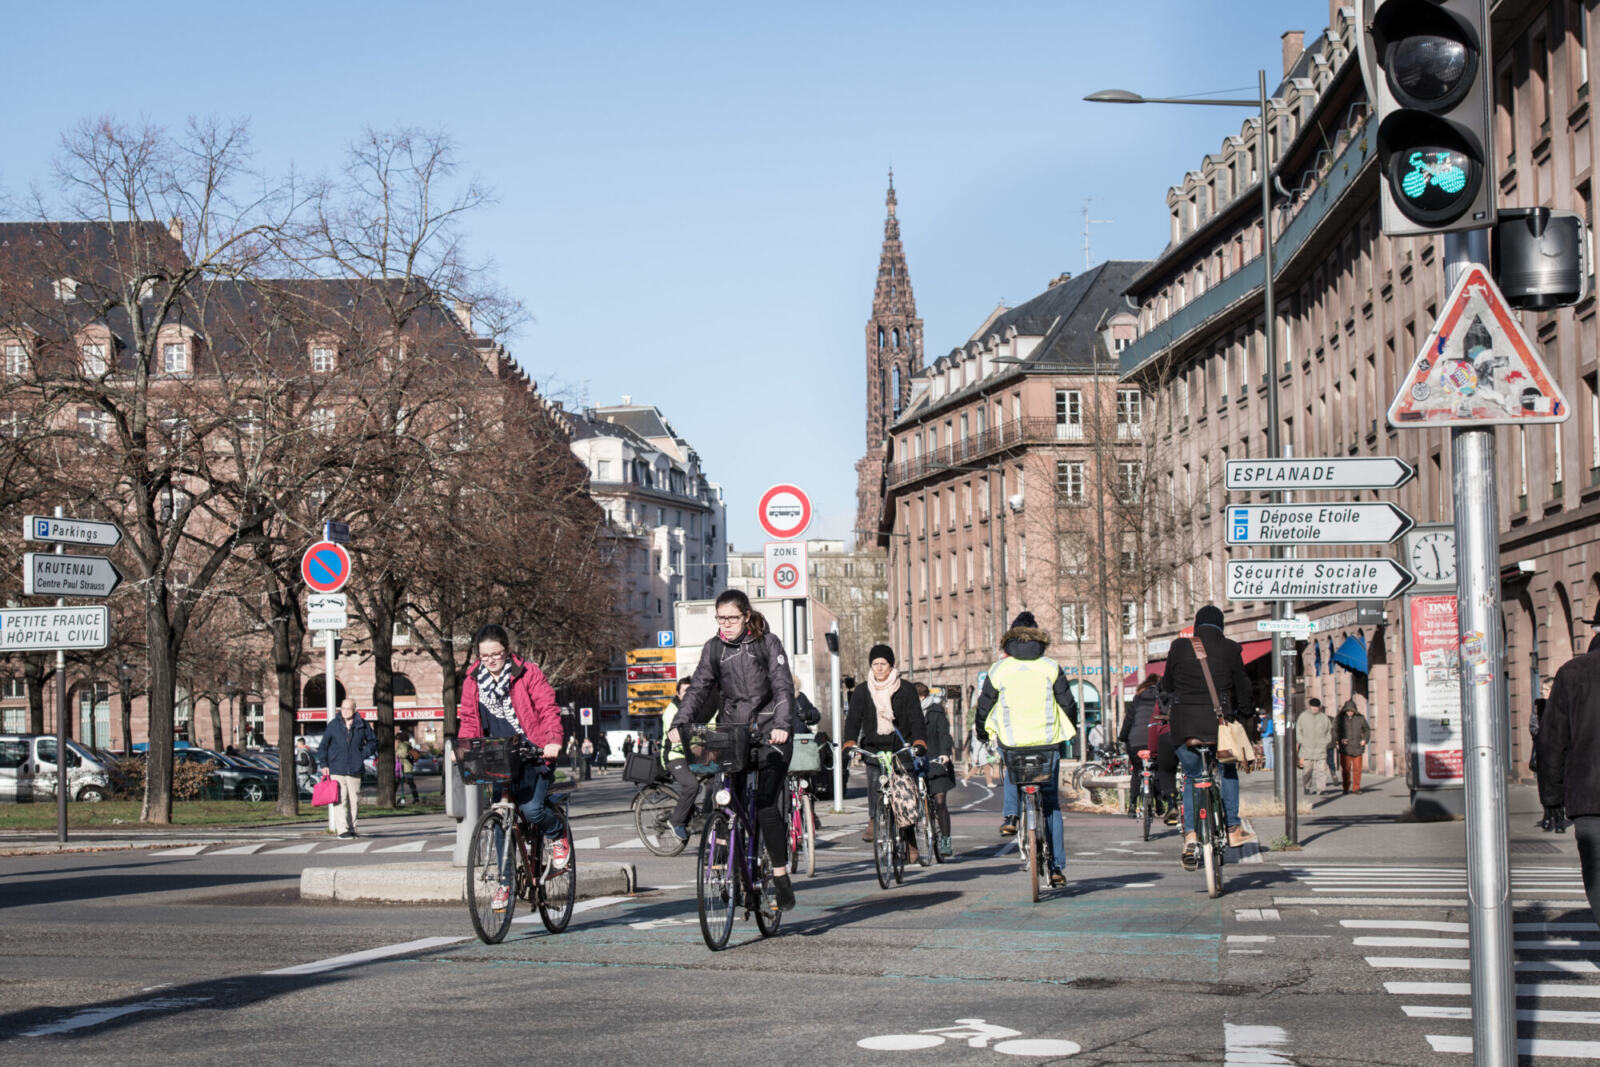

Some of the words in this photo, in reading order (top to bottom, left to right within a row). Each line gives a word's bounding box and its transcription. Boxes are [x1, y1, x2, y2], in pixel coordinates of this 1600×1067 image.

[1233, 466, 1335, 481] ESPLANADE
[1260, 509, 1313, 526] Dépose
[1318, 508, 1360, 523] Etoile
[52, 524, 98, 541] Parkings
[1259, 525, 1321, 539] Rivetoile
[773, 547, 798, 556] ZONE
[37, 562, 94, 576] KRUTENAU
[1233, 564, 1304, 579] Sécurité
[1314, 563, 1378, 578] Sociale
[778, 570, 795, 583] 30
[37, 578, 61, 589] Centre
[62, 579, 78, 589] Paul
[80, 580, 105, 591] Strauss
[1233, 581, 1264, 595] Cité
[1269, 580, 1378, 595] Administrative
[7, 615, 48, 628] PETITE
[52, 613, 101, 626] FRANCE
[7, 629, 60, 643] HÔPITAL
[67, 629, 101, 641] CIVIL
